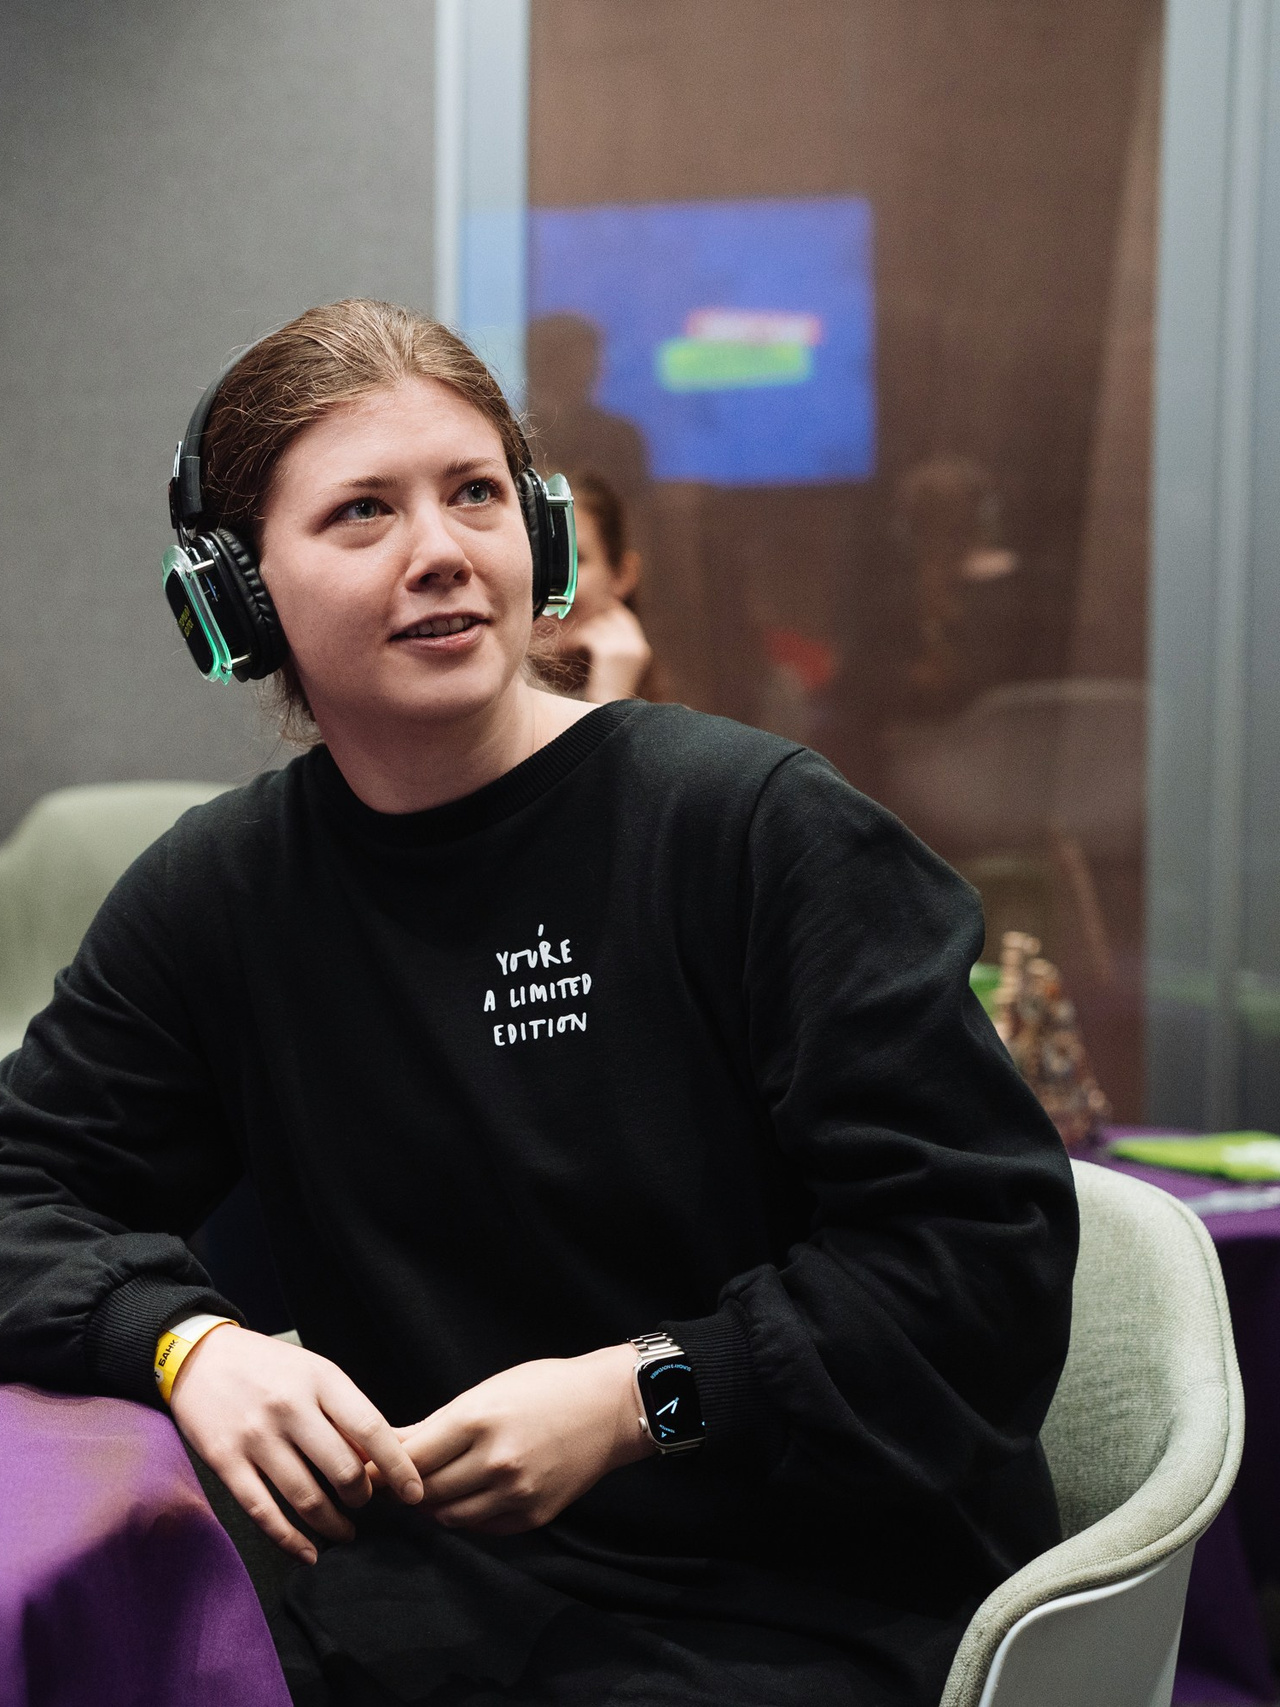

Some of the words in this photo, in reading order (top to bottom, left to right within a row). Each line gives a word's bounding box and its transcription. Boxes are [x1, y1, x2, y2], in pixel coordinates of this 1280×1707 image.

[483, 989, 496, 1012] A
[509, 973, 592, 1008] LIMITED
[493, 1012, 587, 1046] EDITION
[158, 1339, 178, 1367] БАНК
